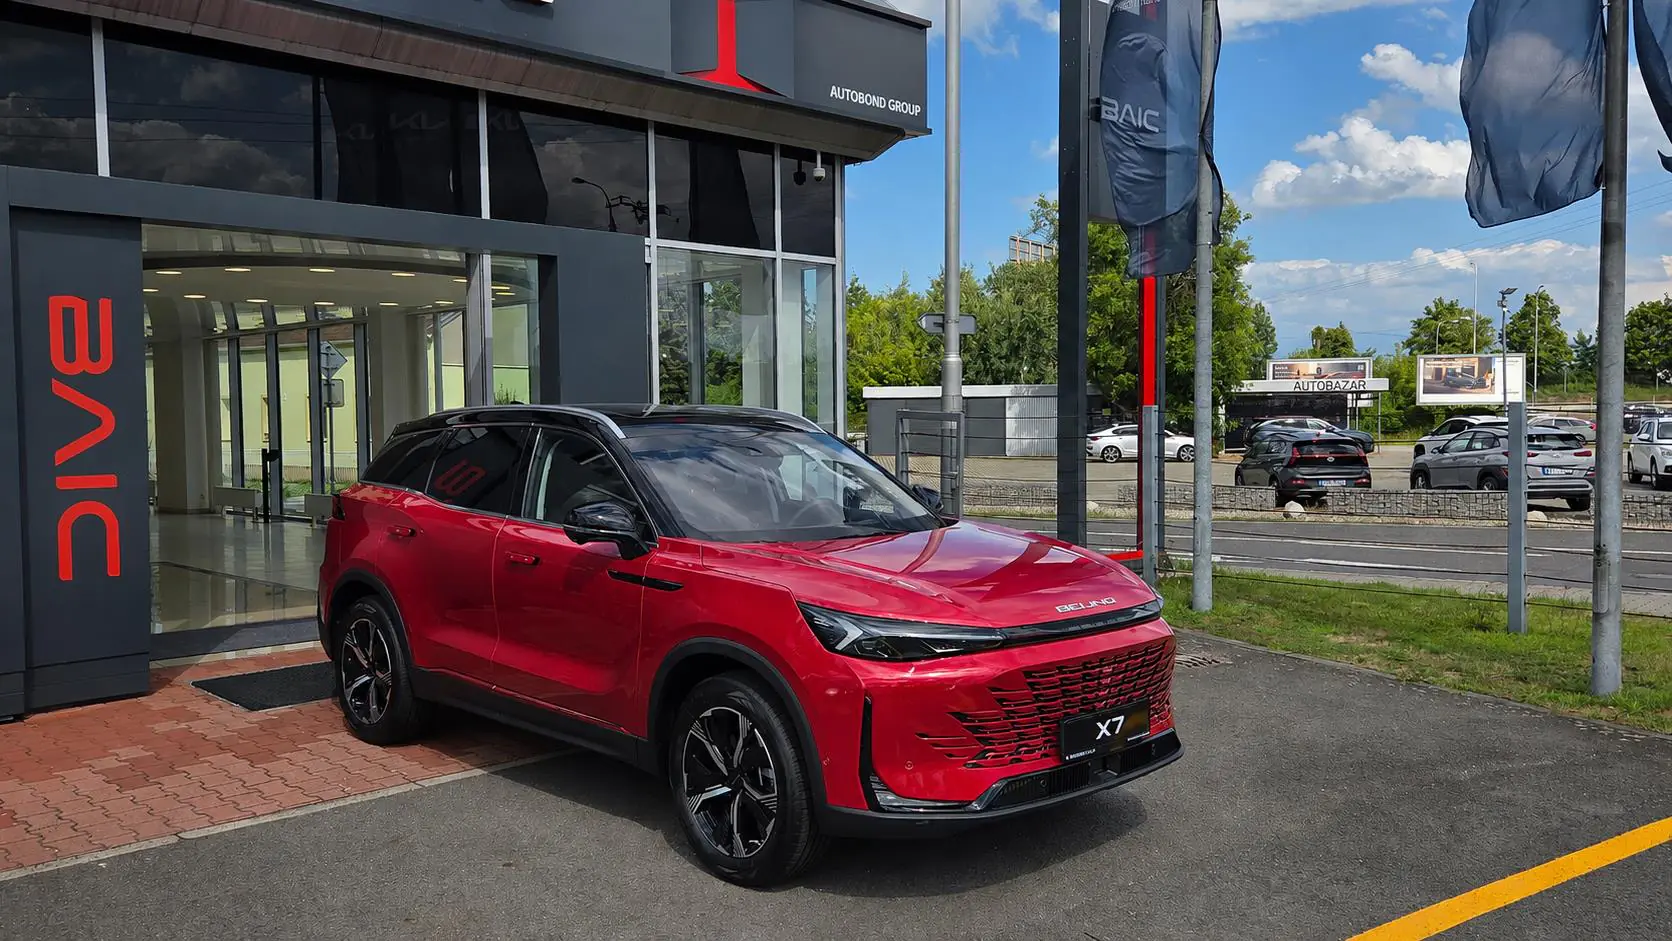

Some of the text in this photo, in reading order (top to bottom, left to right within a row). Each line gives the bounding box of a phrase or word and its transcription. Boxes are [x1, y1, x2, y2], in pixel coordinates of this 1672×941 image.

[830, 85, 921, 116] AUTOBOND GROUP
[1101, 96, 1160, 133] BAIC
[1293, 380, 1367, 391] AUTOBAZAR
[48, 295, 121, 581] BAIC
[1095, 715, 1125, 740] X7
